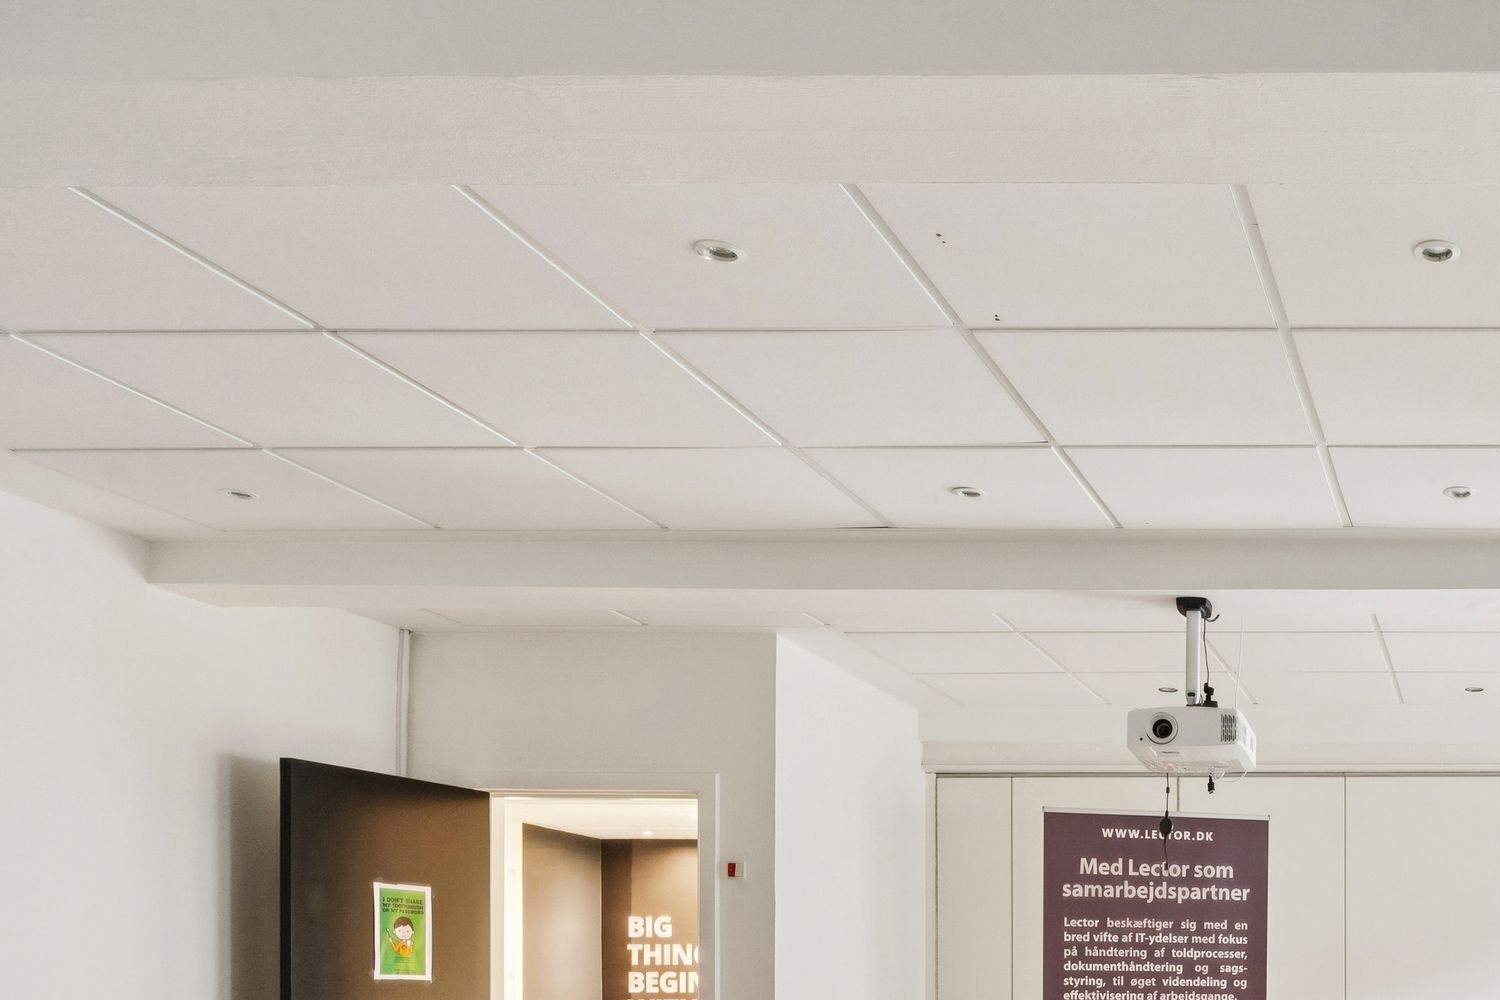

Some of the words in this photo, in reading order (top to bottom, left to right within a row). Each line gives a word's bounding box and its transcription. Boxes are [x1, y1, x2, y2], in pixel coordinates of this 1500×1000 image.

[1080, 858, 1122, 875] Med
[1129, 859, 1189, 877] Lector
[1194, 865, 1233, 878] som
[1063, 881, 1250, 904] samarbejdspartner
[628, 915, 672, 938] BIG
[1064, 917, 1099, 927] Lector
[1107, 917, 1173, 931] beskæftiger
[1181, 919, 1196, 931] sig
[1204, 920, 1227, 929] med
[1064, 931, 1090, 941] bred
[1093, 932, 1118, 942] vifte
[1122, 932, 1133, 942] af
[1136, 933, 1188, 945] IT-ydelser
[1192, 934, 1215, 943] med
[1218, 934, 1248, 944] fokus
[627, 943, 698, 966] THIN
[1064, 946, 1077, 958] på
[1085, 946, 1147, 959] håndtering
[1154, 947, 1165, 957] af
[1172, 948, 1247, 960] toldprocesser,
[1064, 961, 1183, 974] dokumenthåndtering
[1195, 965, 1208, 974] og
[1220, 965, 1247, 975] sags-
[1064, 976, 1106, 988] styring,
[1113, 976, 1123, 986] til
[1131, 978, 1156, 988] øget
[1162, 976, 1227, 989] videndeling
[1233, 980, 1247, 989] og
[1147, 991, 1158, 1000] af
